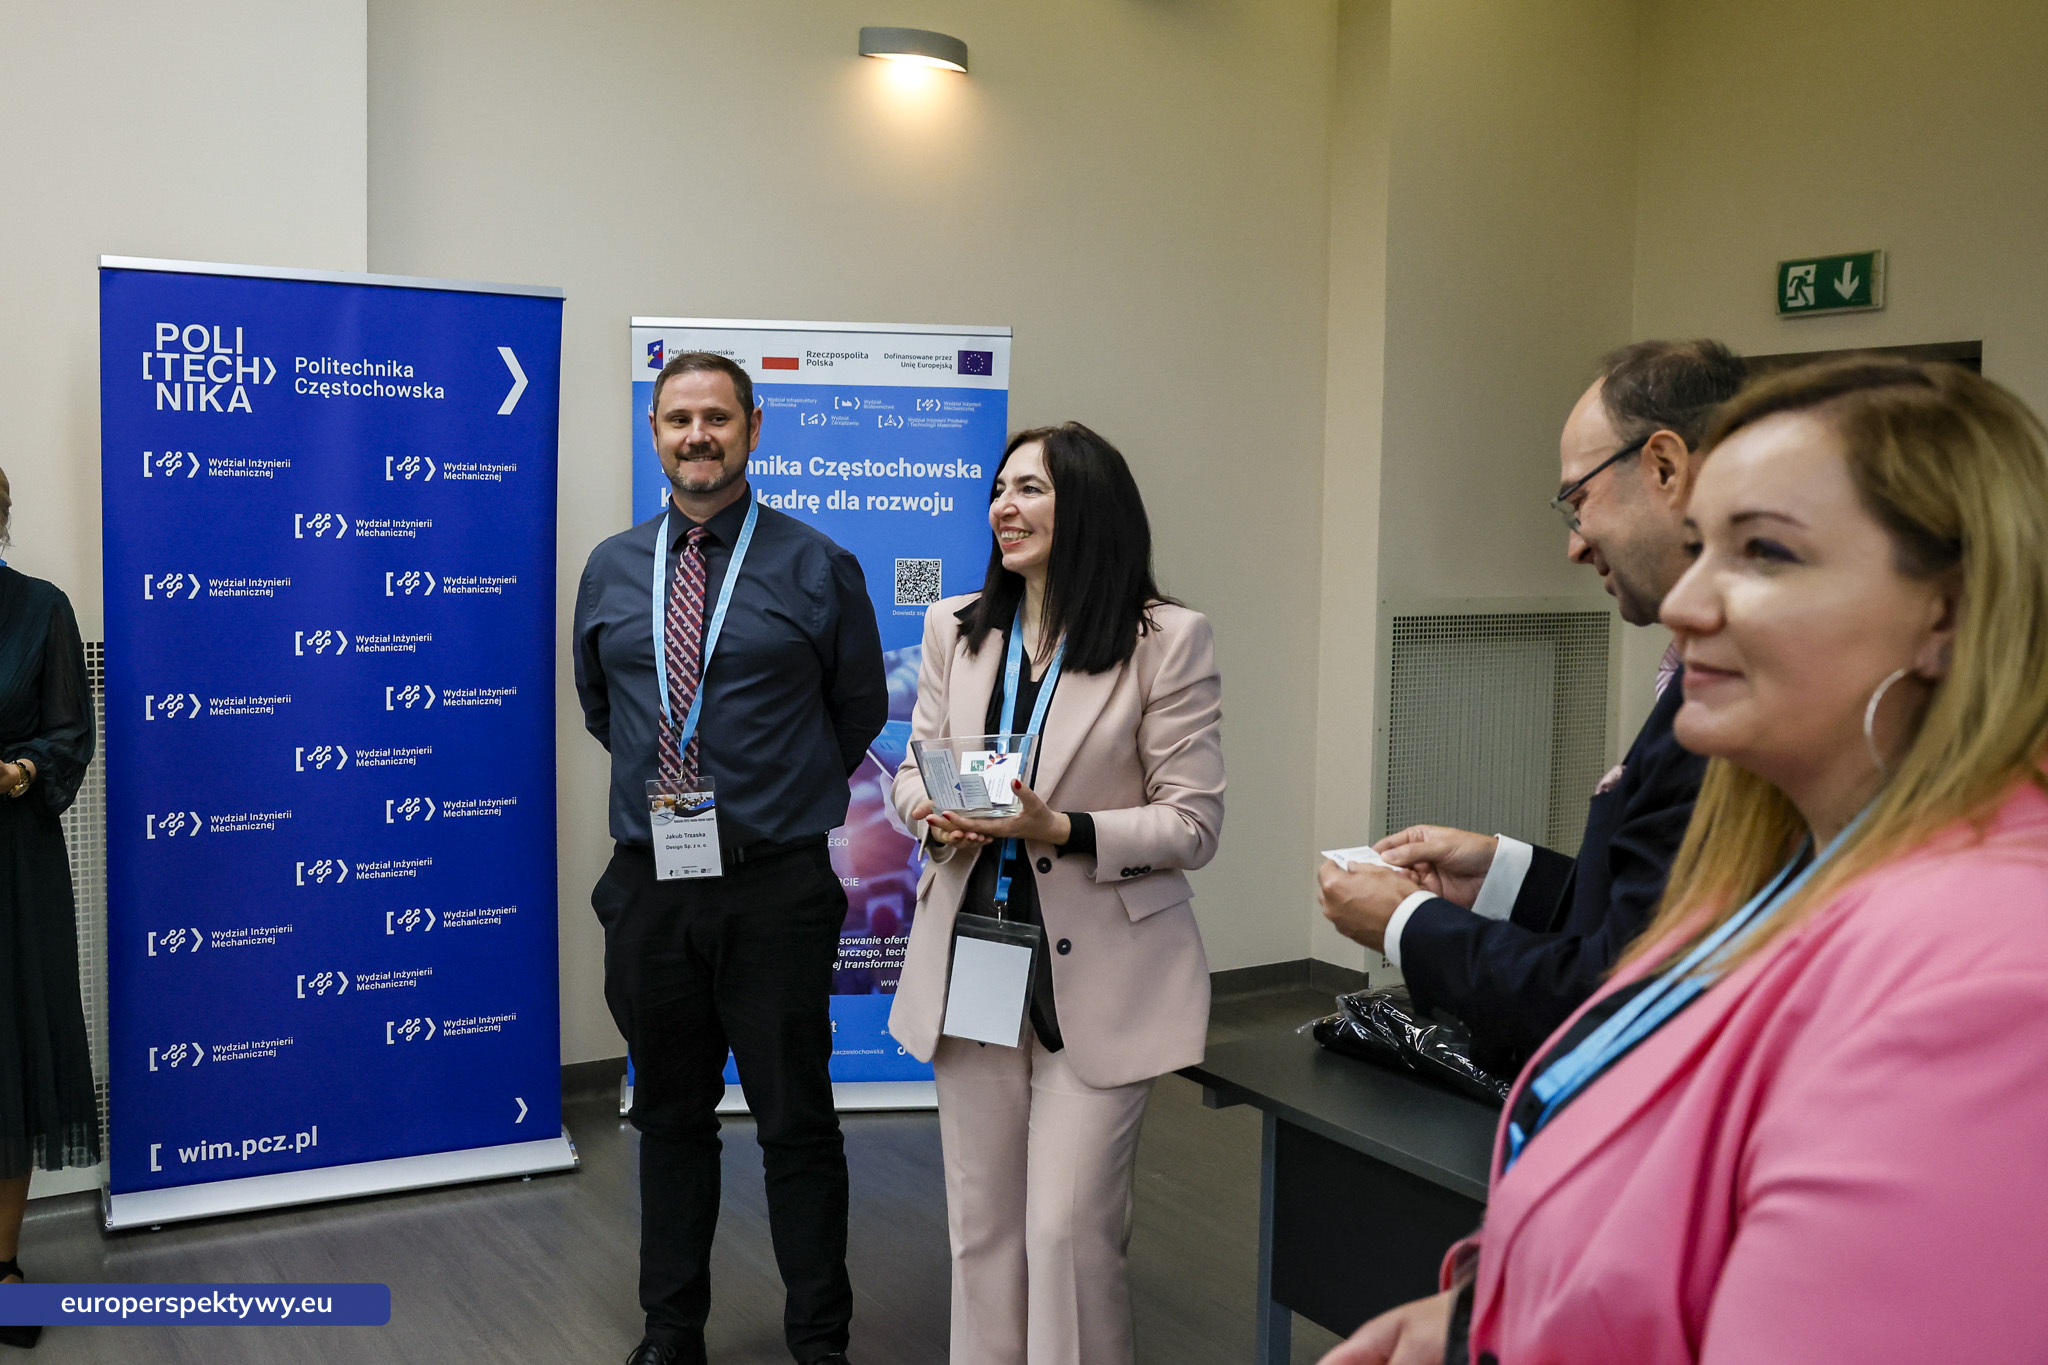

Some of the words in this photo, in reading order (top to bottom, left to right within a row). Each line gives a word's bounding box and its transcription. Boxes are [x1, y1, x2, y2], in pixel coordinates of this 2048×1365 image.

[156, 322, 242, 354] POLI
[806, 350, 869, 360] Rzeczpospolita
[295, 357, 414, 378] Politechnika
[294, 378, 444, 400] Częstochowska
[156, 382, 252, 413] NIKA
[209, 458, 245, 468] Wydział
[249, 459, 290, 469] Inżynierii
[444, 463, 477, 472] Wydział
[479, 463, 516, 473] Inżynierii
[808, 456, 982, 480] Częstochowska
[209, 467, 273, 479] Mechanicznej
[444, 471, 501, 482] Mechanicznej
[757, 490, 820, 514] kadrę
[827, 488, 860, 510] dla
[866, 490, 954, 516] rozwoju
[356, 519, 390, 528] Wydział
[393, 519, 432, 529] Inżynierii
[356, 528, 415, 538] Mechanicznej
[209, 578, 245, 588] Wydział
[249, 578, 290, 588] Inżynierii
[444, 576, 476, 586] Wydział
[479, 576, 516, 586] Inżynierii
[210, 587, 273, 597] Mechanicznej
[444, 585, 501, 594] Mechanicznej
[356, 635, 392, 644] Wydział
[393, 633, 432, 644] Inżynierii
[356, 643, 415, 652] Mechanicznej
[443, 689, 476, 698] Wydział
[480, 687, 516, 697] Inżynierii
[210, 696, 246, 707] Wydział
[250, 695, 291, 705] Inżynierii
[444, 697, 501, 706] Mechanicznej
[210, 705, 273, 715] Mechanicznej
[356, 748, 390, 759] Wydział
[393, 746, 432, 757] Inżynierii
[356, 756, 416, 766] Mechanicznej
[443, 800, 476, 809] Wydział
[479, 797, 516, 807] Inżynierii
[211, 813, 246, 824] Wydział
[250, 810, 291, 821] Inżynierii
[444, 807, 501, 817] Mechanicznej
[211, 821, 274, 832] Mechanicznej
[356, 861, 390, 872] Wydział
[393, 858, 432, 870] Inżynierii
[357, 868, 416, 879] Mechanicznej
[444, 909, 476, 920] Wydział
[479, 906, 516, 918] Inżynierii
[444, 916, 500, 927] Mechanicznej
[212, 928, 248, 939] Wydział
[251, 924, 292, 936] Inżynierii
[212, 935, 275, 948] Mechanicznej
[839, 936, 881, 945] sowanie
[357, 972, 390, 982] Wydział
[393, 968, 432, 980] Inżynierii
[357, 978, 416, 990] Mechanicznej
[444, 1017, 476, 1028] Wydział
[479, 1013, 516, 1026] Inżynierii
[444, 1023, 500, 1036] Mechanicznej
[213, 1042, 248, 1053] Wydział
[252, 1037, 293, 1049] Inżynierii
[213, 1048, 276, 1061] Mechanicznej
[178, 1126, 318, 1163] wim.pcz.pl
